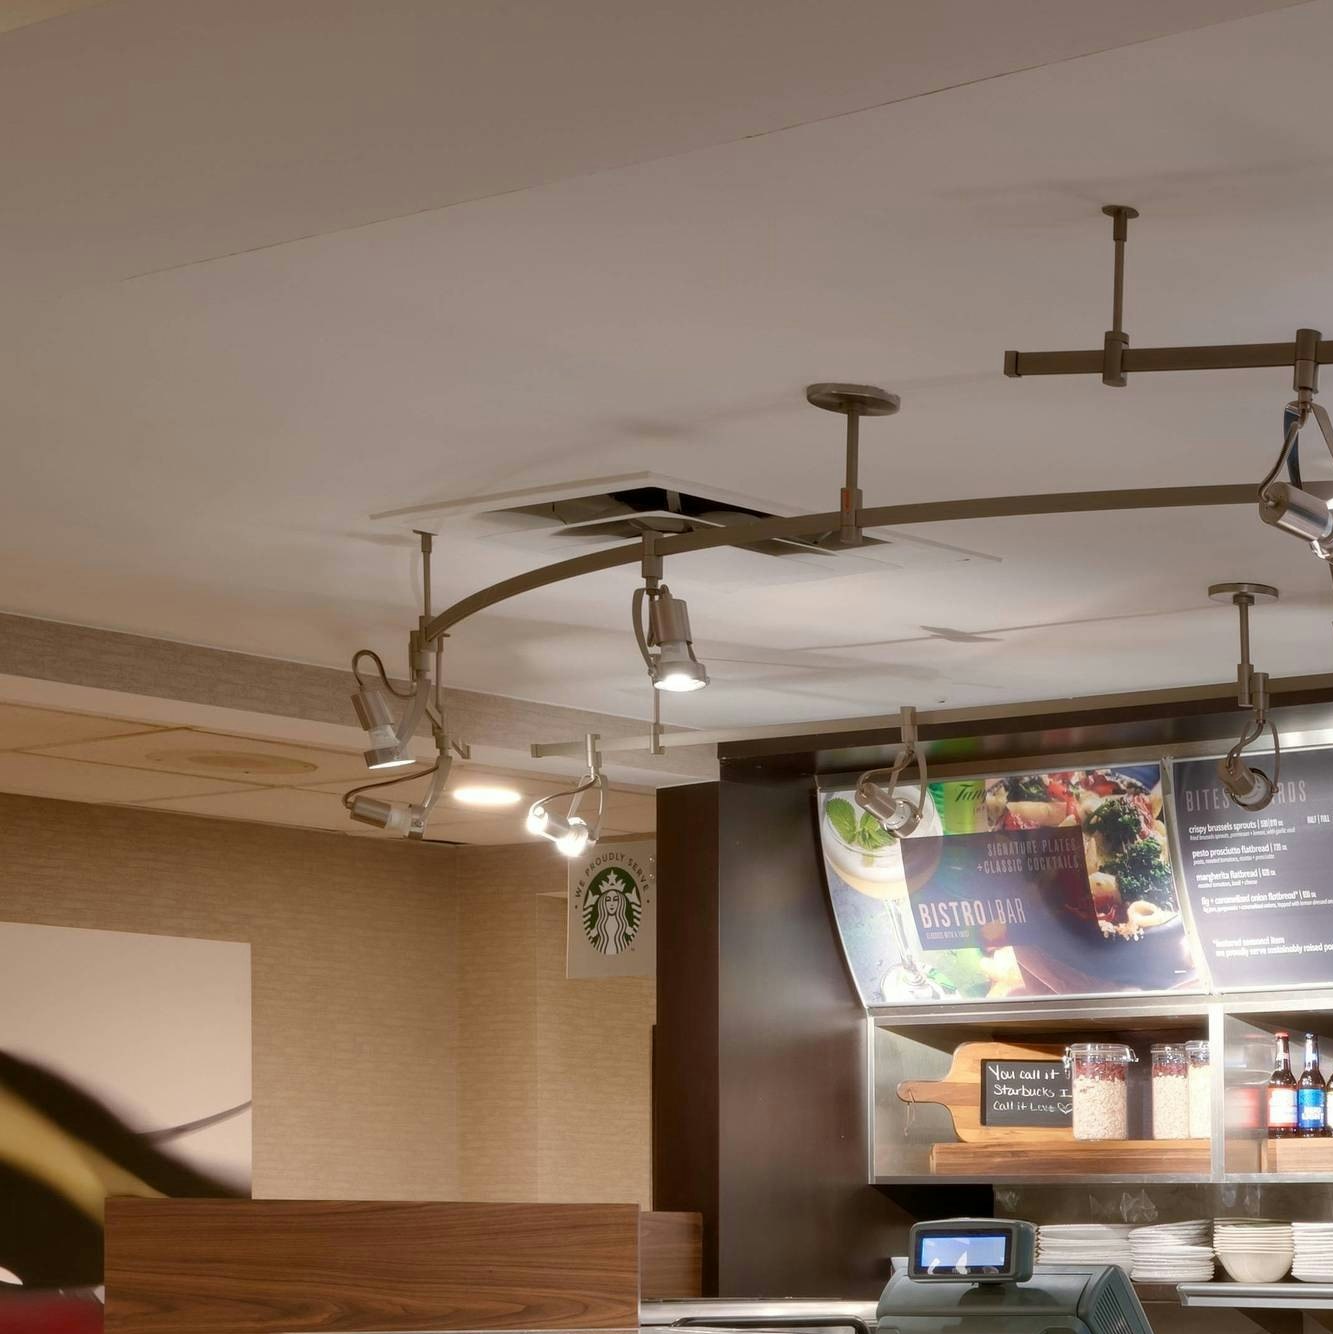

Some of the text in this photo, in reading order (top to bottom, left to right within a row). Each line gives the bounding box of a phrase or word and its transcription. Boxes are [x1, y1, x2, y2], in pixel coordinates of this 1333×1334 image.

[1189, 823, 1206, 835] crispy
[1207, 823, 1232, 832] brussels
[1233, 821, 1256, 832] sprouts
[987, 838, 1077, 857] SIGNATURE PLATES
[1027, 855, 1078, 871] COCKTAILS
[575, 852, 650, 898] WE PROUDLY SERVE
[988, 1064, 1060, 1080] You call it
[994, 1084, 1055, 1097] Starbucks
[993, 1100, 1056, 1111] Call it Love
